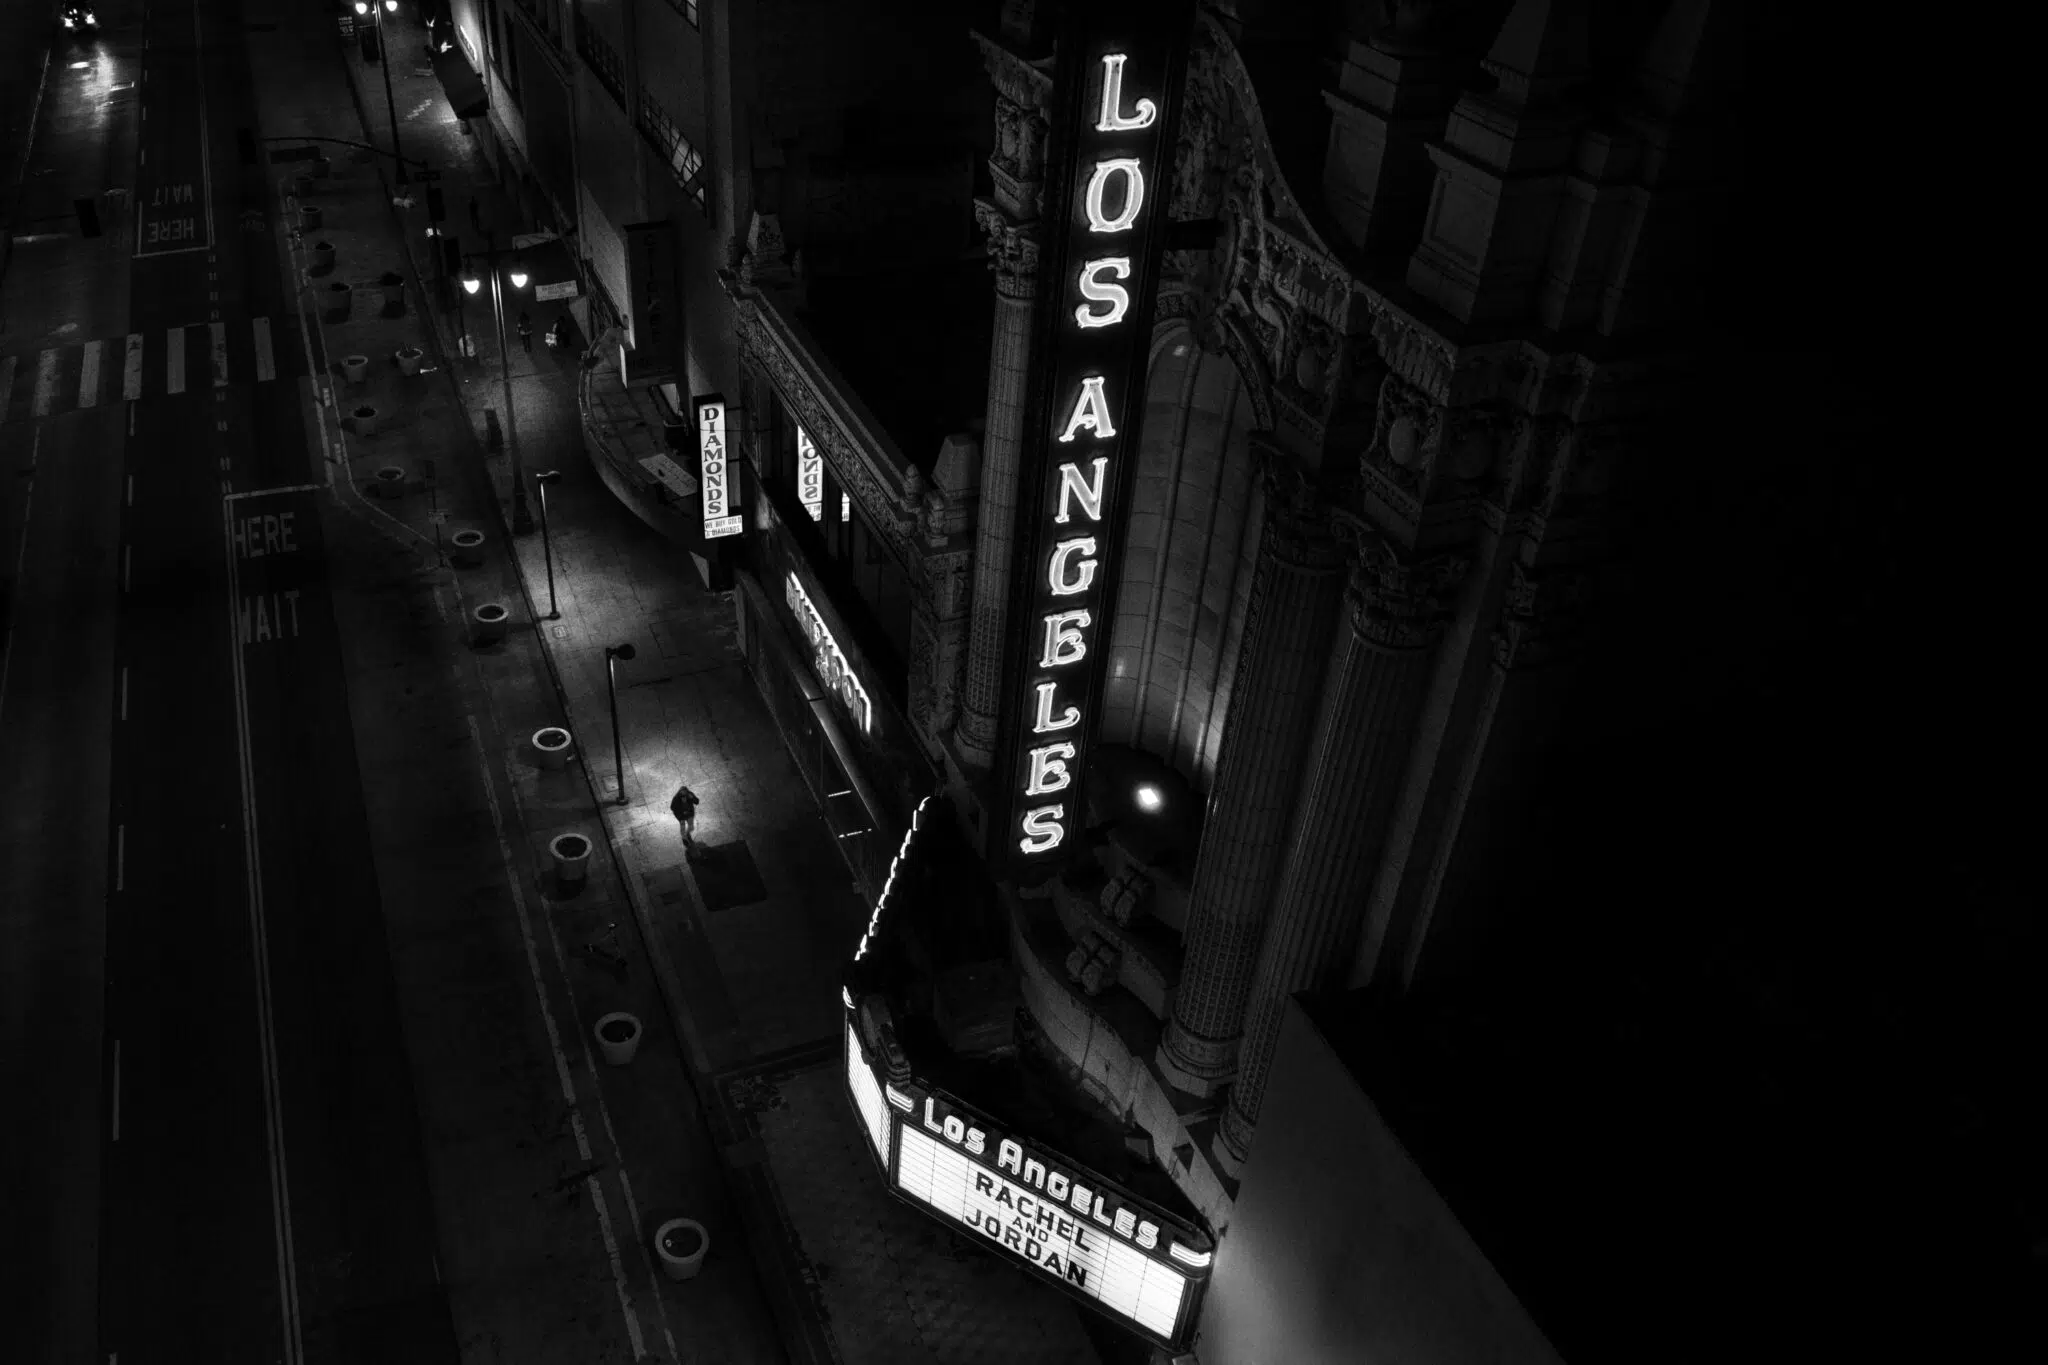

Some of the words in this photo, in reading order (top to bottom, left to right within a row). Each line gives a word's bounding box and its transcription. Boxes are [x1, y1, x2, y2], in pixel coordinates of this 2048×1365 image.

[151, 184, 194, 208] WAIT
[1075, 53, 1157, 328] LOS
[147, 217, 195, 243] HERE
[703, 407, 723, 515] DIAMONDS
[232, 512, 298, 559] HERE
[239, 588, 300, 644] WAIT
[1019, 376, 1117, 854] ANGELES
[975, 1171, 1092, 1253] RACHEL
[1012, 1215, 1049, 1244] AND
[965, 1209, 1088, 1287] JORDAN
